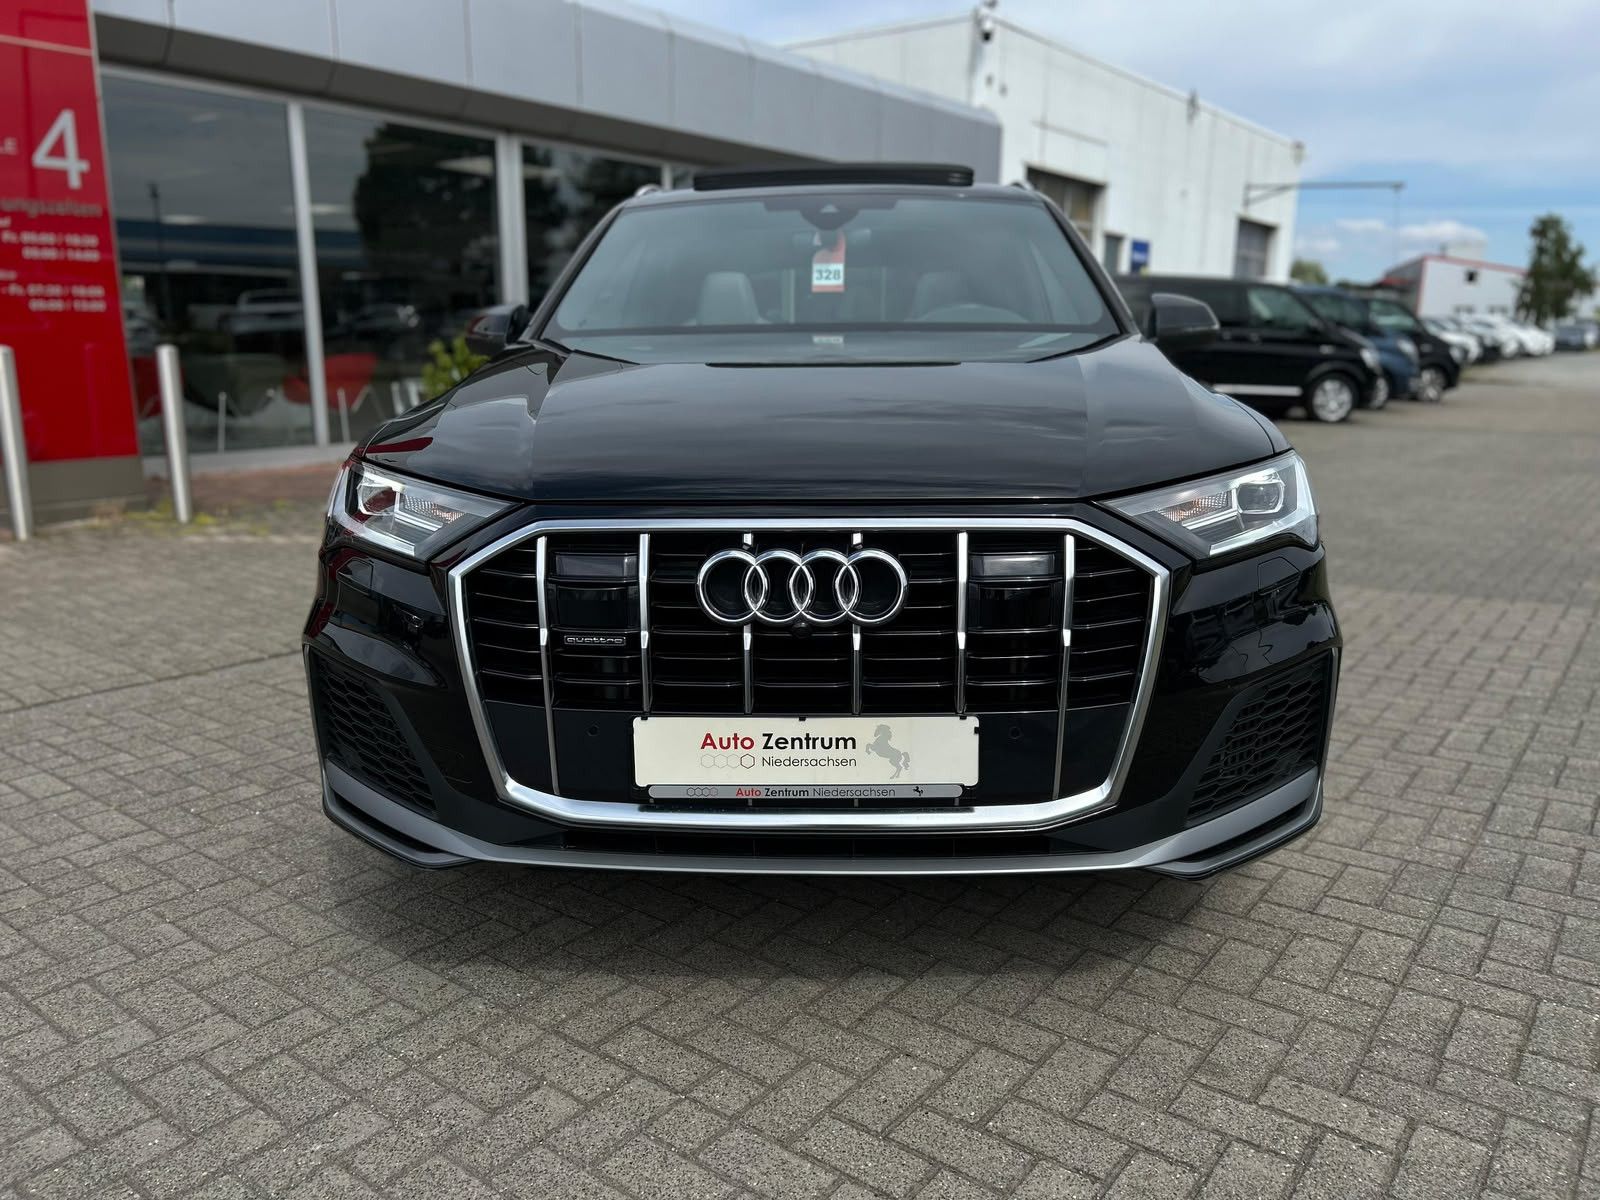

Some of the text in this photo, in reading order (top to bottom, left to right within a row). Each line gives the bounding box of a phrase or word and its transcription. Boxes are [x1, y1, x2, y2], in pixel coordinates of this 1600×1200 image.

[32, 108, 91, 190] 4
[566, 637, 623, 645] quattro
[700, 732, 857, 750] Auto Zentrum
[762, 756, 857, 767] Niedersachsen
[735, 787, 896, 797] Auto Zentrum Niedersachsen
